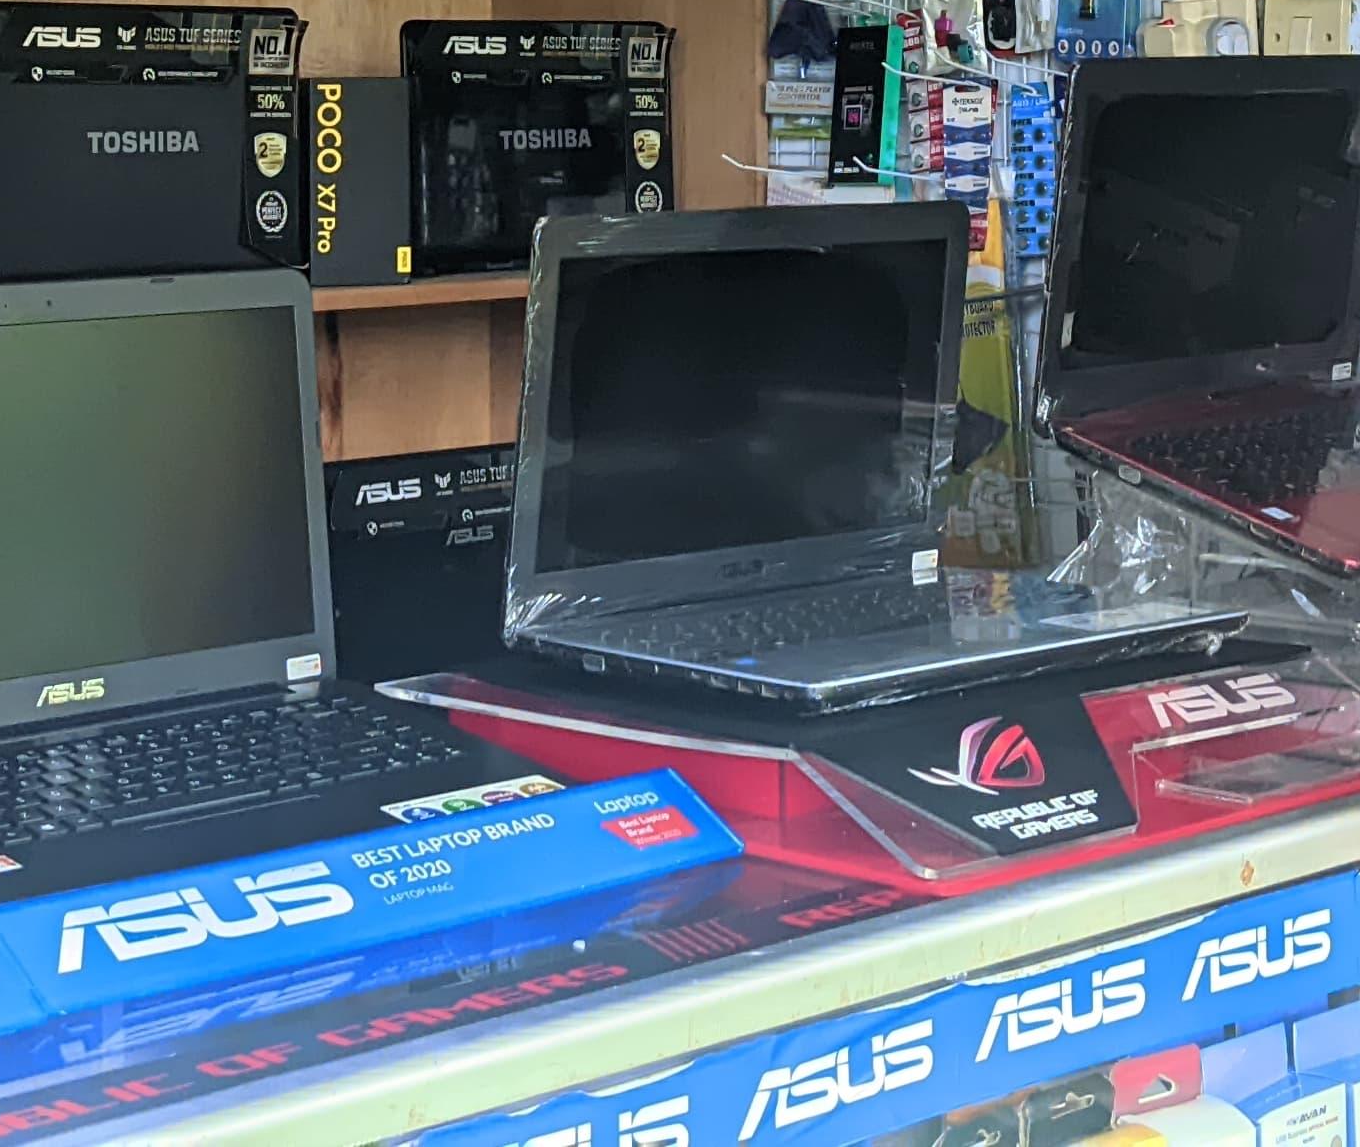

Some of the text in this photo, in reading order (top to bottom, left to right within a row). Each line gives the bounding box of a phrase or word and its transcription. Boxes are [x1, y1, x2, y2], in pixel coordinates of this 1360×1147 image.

[22, 26, 102, 48] ASUS
[145, 27, 242, 45] ASUS TUF SERIES
[254, 25, 291, 56] NO.1
[443, 35, 507, 55] ASUS
[543, 36, 622, 51] ASUS TUF SERIES
[256, 93, 286, 111] 50%
[635, 95, 659, 110] 50%
[87, 129, 200, 156] TOSHIBA
[258, 142, 269, 158] 2
[499, 128, 593, 151] TOSHIBA
[637, 138, 646, 154] 2
[317, 84, 343, 254] POCO X7 Pro
[460, 469, 487, 484] ASUS
[355, 477, 422, 506] ASUS
[446, 525, 493, 546] ASUS
[36, 677, 106, 708] ASUS
[1145, 673, 1298, 730] ASUS
[593, 791, 660, 815] Laptop
[971, 789, 1099, 831] REPUBLIC OF
[1009, 808, 1100, 840] GAMERS
[351, 813, 556, 870] BEST LAPTOP BRAND
[369, 859, 453, 890] OF 2020
[383, 882, 455, 906] LAPTOP MAG
[57, 860, 356, 976] ASUS
[1181, 908, 1332, 1002] ASUS
[197, 961, 630, 1079] OF GAMERS
[975, 958, 1146, 1063] ASUS
[738, 1019, 934, 1141] ASUS
